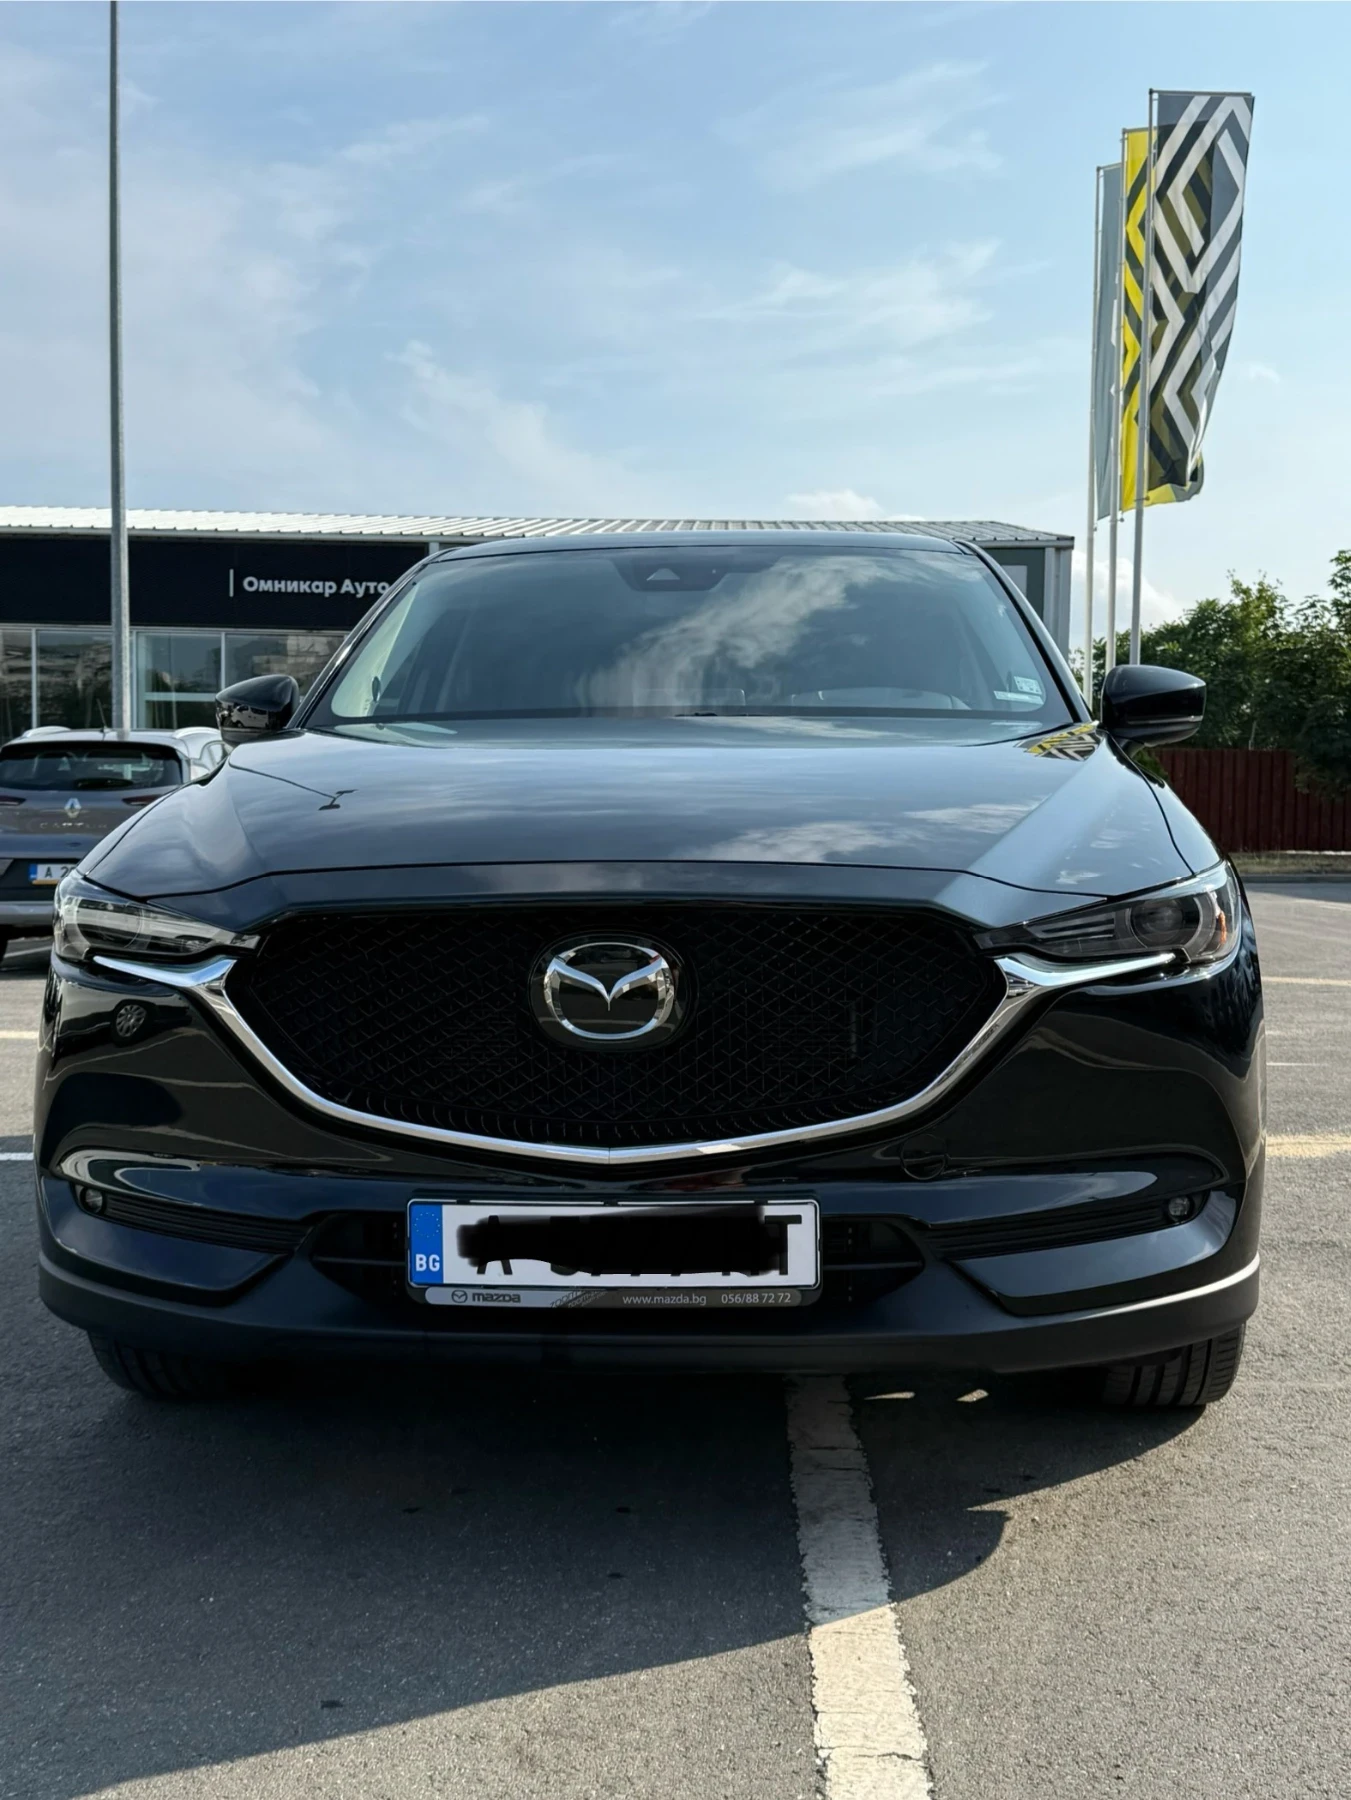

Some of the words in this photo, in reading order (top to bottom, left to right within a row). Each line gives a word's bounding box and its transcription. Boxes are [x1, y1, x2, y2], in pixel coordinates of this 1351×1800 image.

[243, 576, 337, 598] Омникар
[340, 579, 389, 598] Ауто
[45, 866, 53, 878] A
[415, 1253, 440, 1272] BG
[472, 1292, 521, 1303] mazda
[622, 1293, 707, 1306] www.mazda.bg
[721, 1293, 759, 1304] 056/88
[761, 1293, 776, 1304] 72
[777, 1292, 792, 1303] 72
